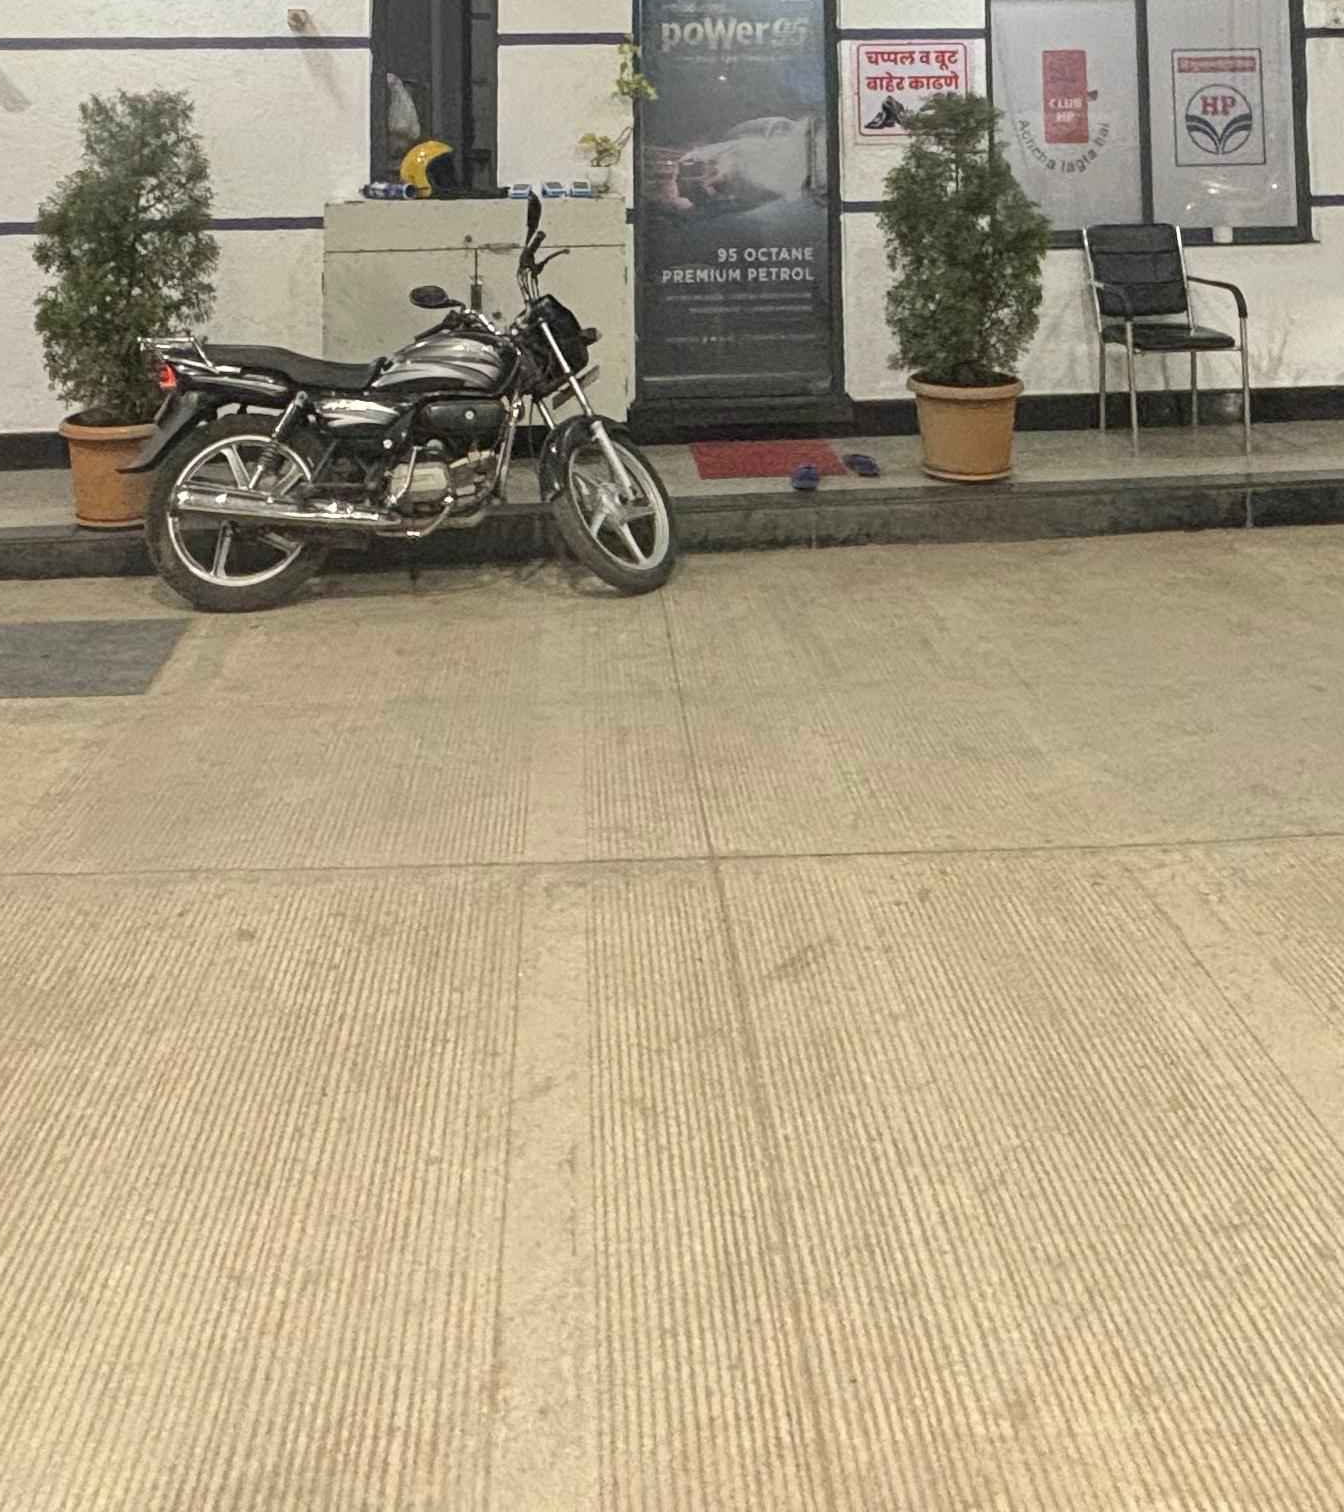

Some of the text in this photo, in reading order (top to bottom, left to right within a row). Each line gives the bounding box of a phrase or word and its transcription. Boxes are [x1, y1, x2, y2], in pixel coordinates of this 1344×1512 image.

[865, 51, 915, 65] चप्पल
[933, 51, 959, 70] बूट
[908, 71, 959, 90] काढणे
[1200, 95, 1236, 116] HP
[717, 247, 814, 263] 95 OCTANE
[661, 267, 814, 283] PREMIUM PETROL
